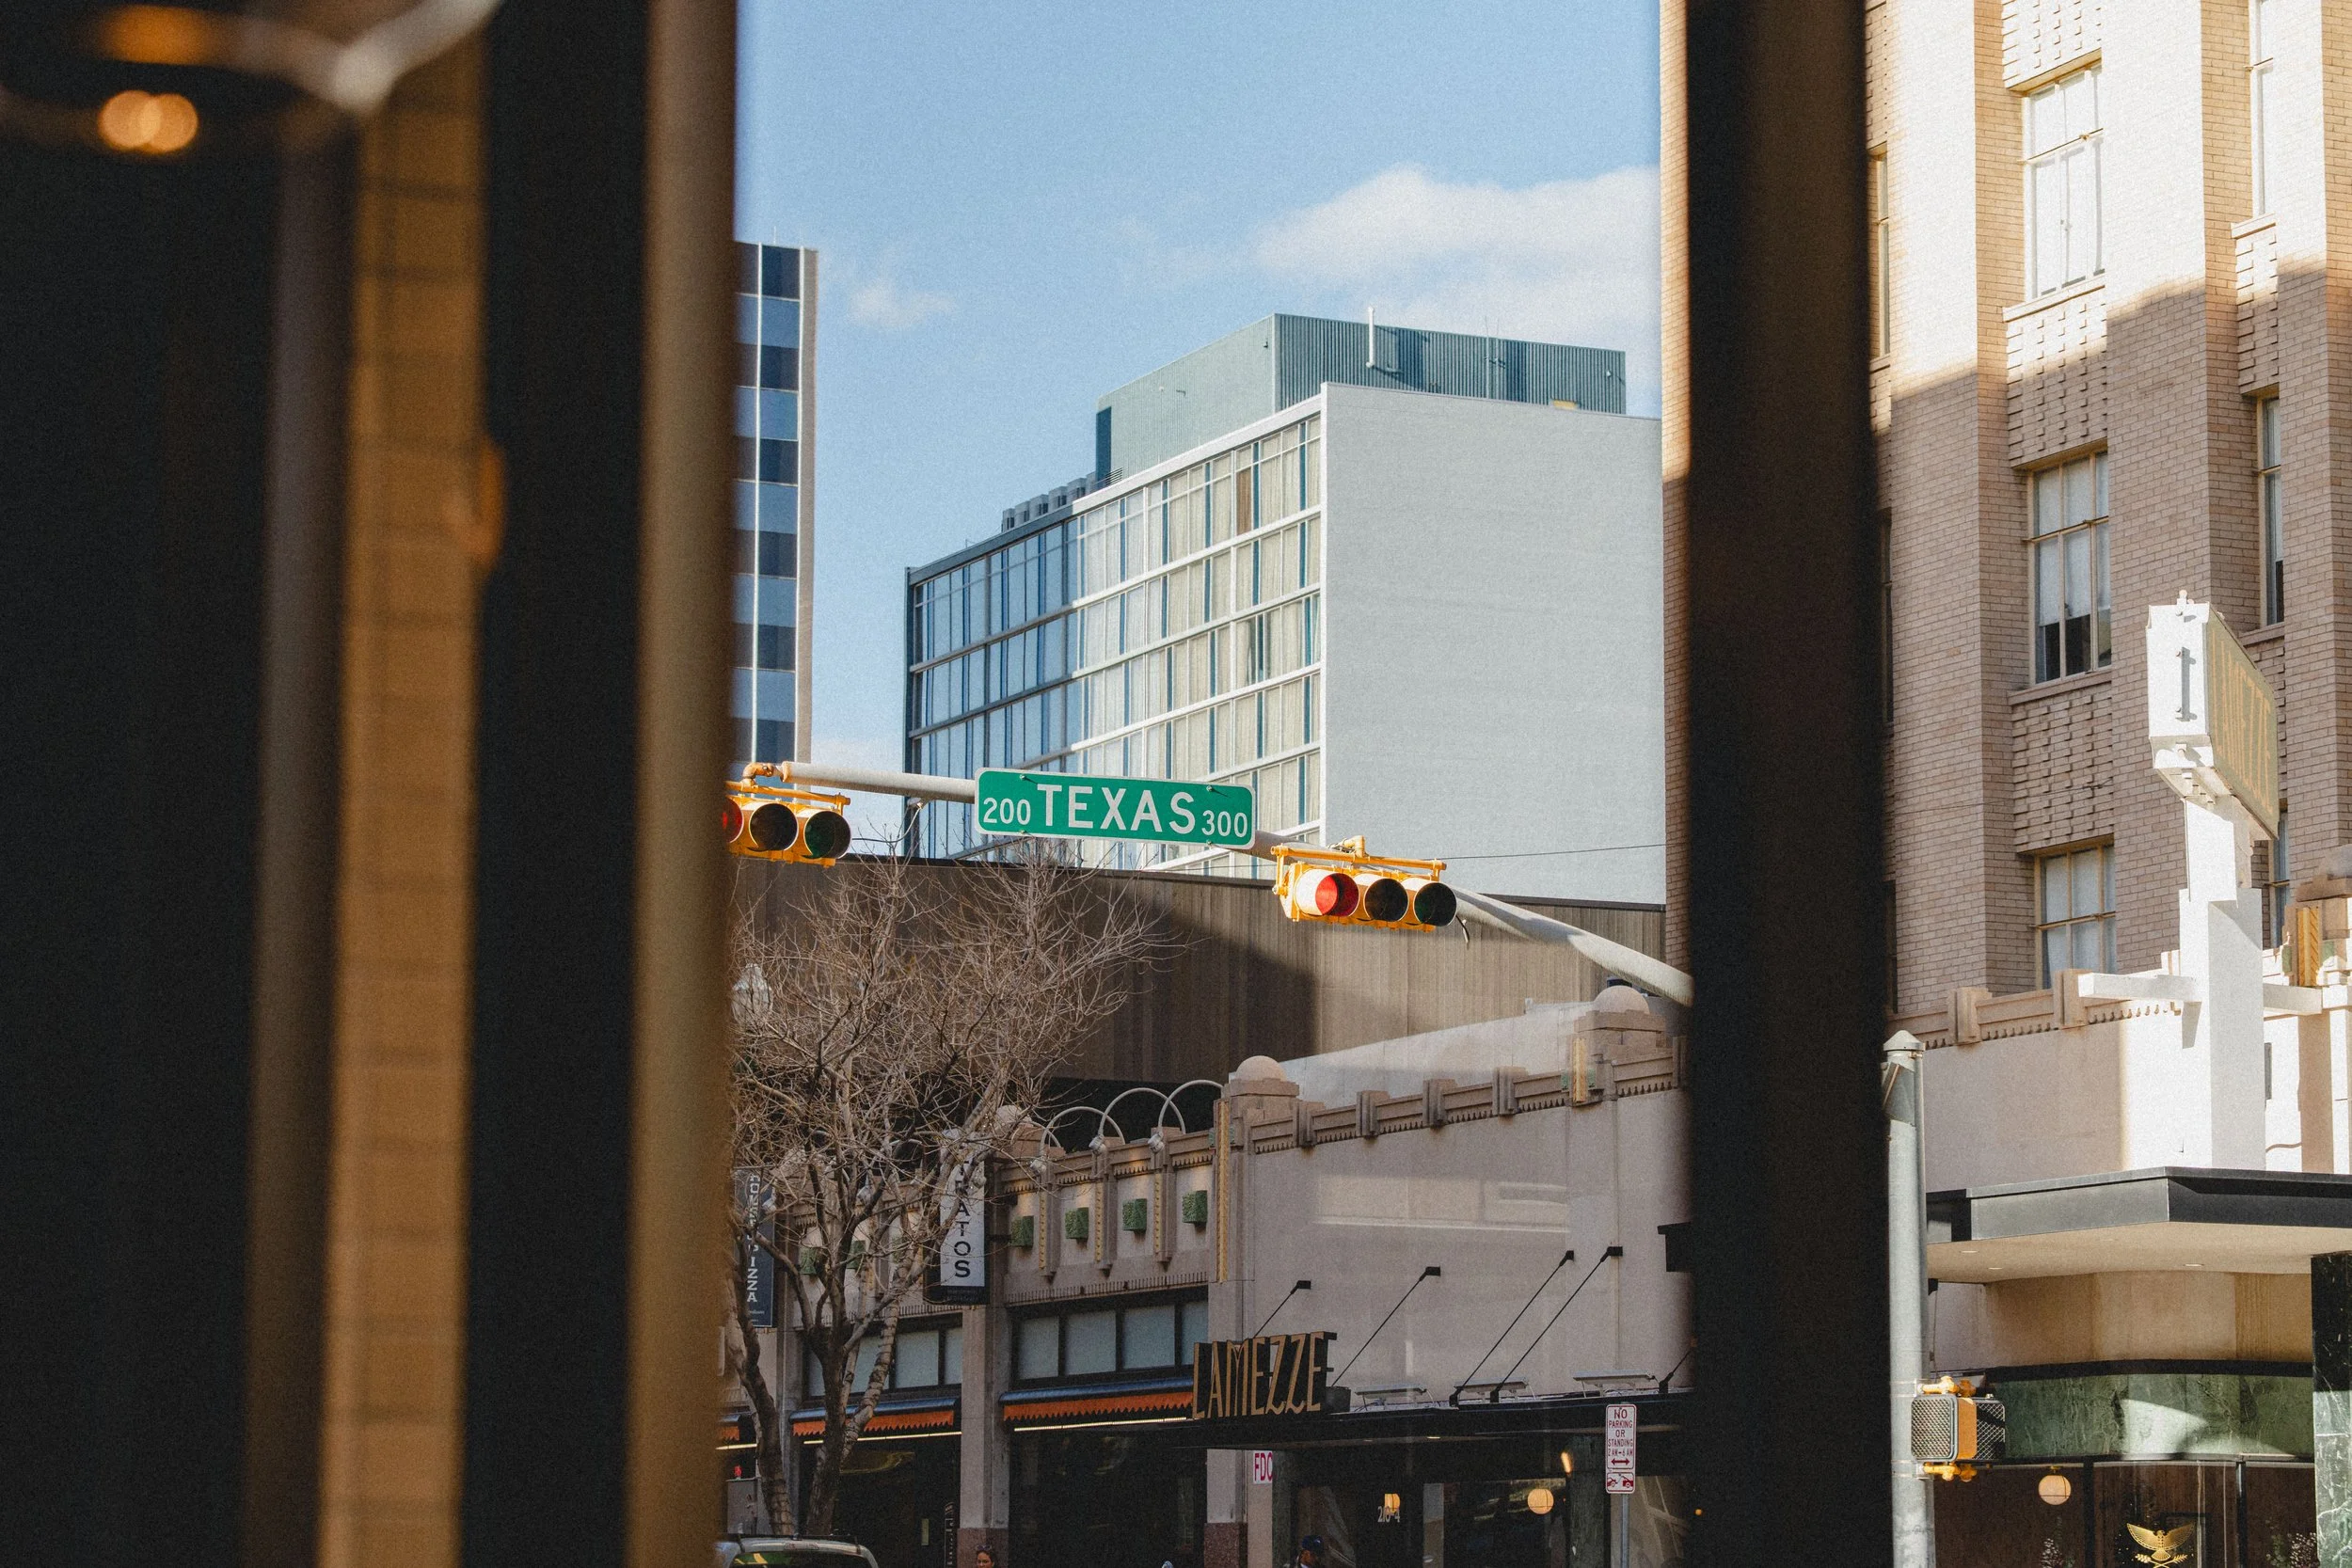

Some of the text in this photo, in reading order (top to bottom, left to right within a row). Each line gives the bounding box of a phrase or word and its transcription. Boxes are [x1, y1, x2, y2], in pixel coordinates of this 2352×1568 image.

[983, 784, 1248, 838] 200 TEXAS 300
[1613, 1409, 1628, 1418] NO
[1608, 1419, 1633, 1428] PARKING
[1608, 1438, 1633, 1447] STANDING
